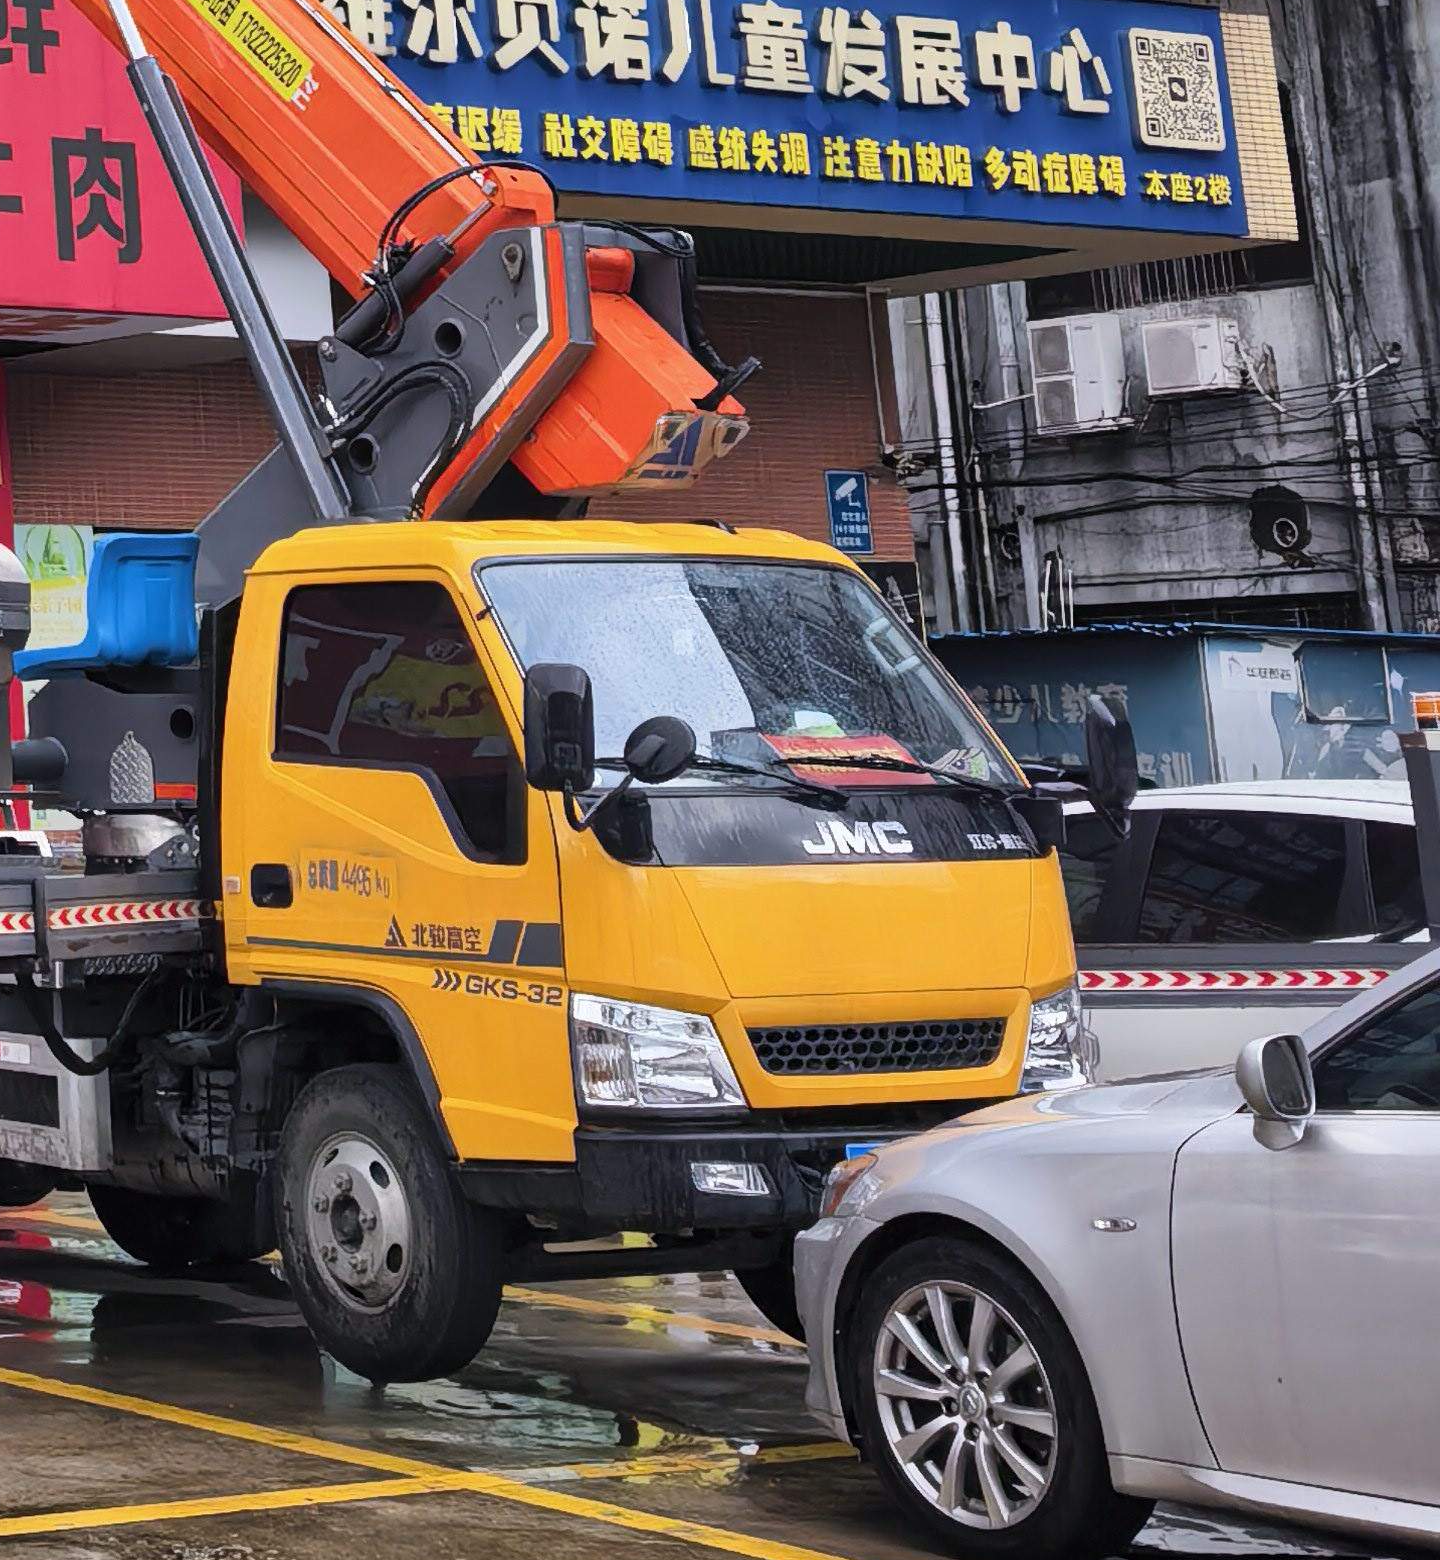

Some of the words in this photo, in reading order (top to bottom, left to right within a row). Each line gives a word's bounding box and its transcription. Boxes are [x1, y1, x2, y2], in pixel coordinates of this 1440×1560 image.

[543, 112, 674, 167] 社交障碍
[687, 124, 812, 176] 感统失调
[822, 135, 974, 188] 注意力缺陷
[984, 145, 1127, 198] 多动症障碍
[1143, 170, 1233, 207] 本座2楼
[801, 820, 914, 856] JMC
[465, 974, 563, 1007] GKS-32
